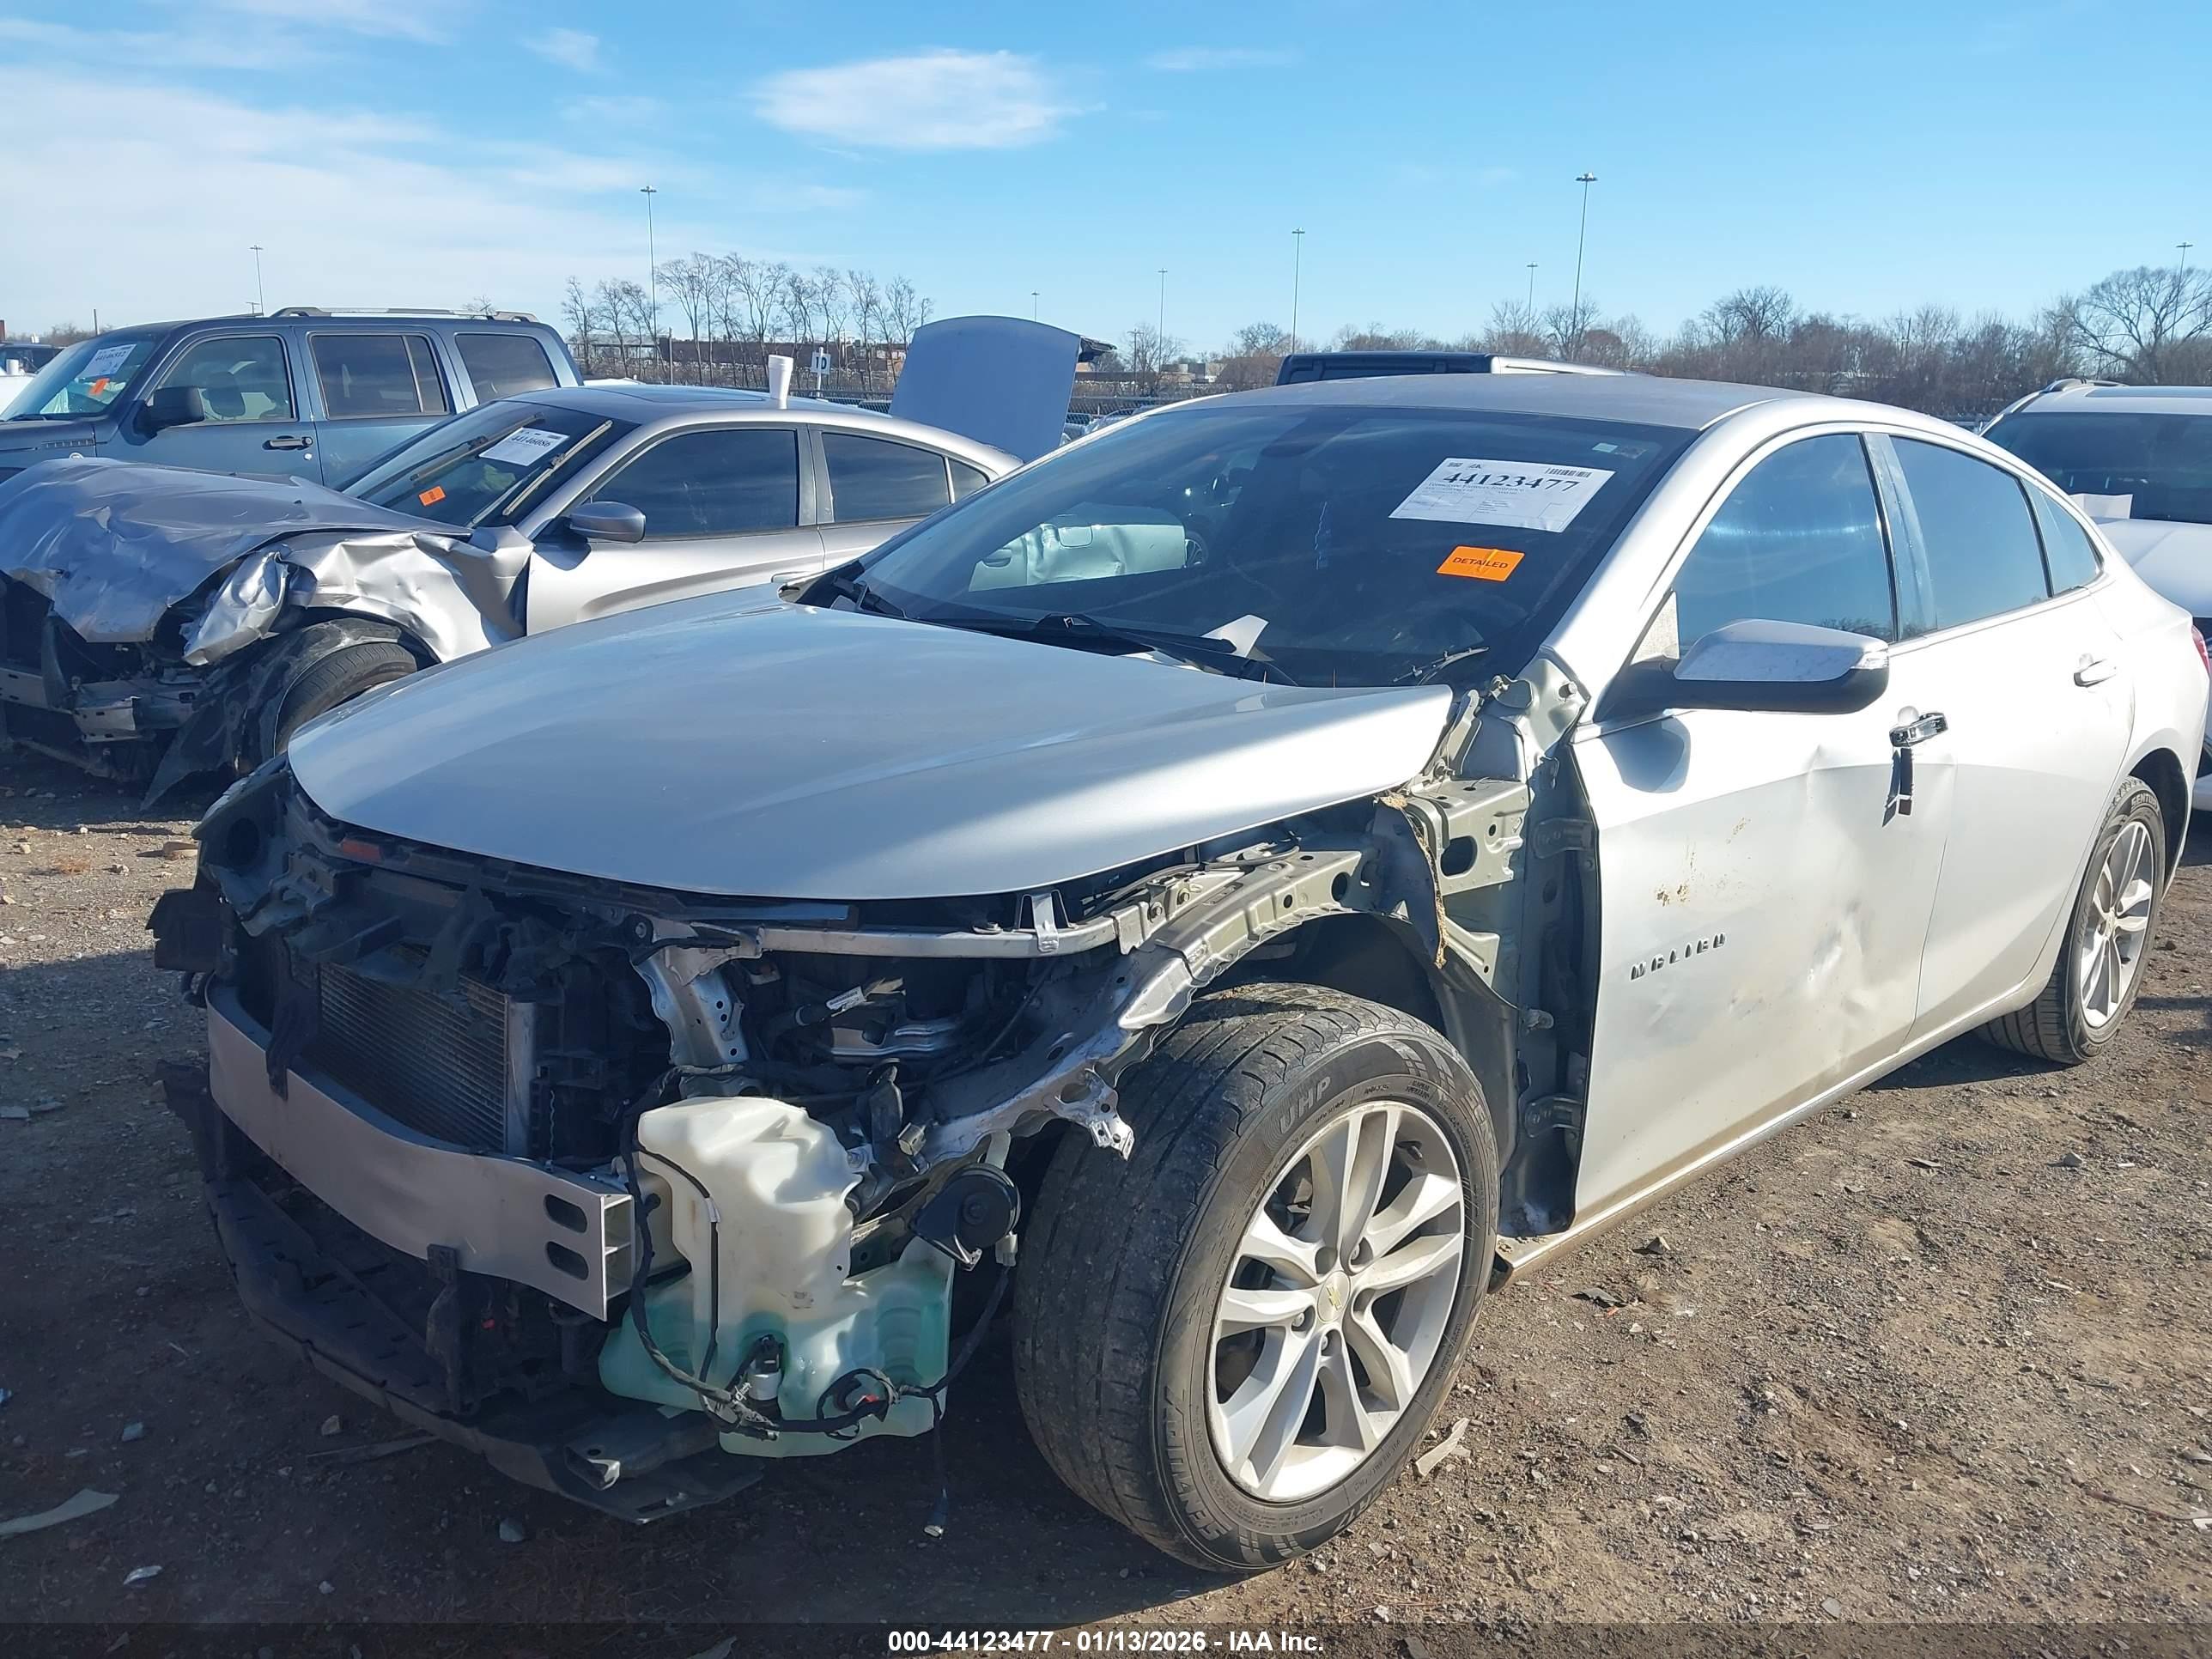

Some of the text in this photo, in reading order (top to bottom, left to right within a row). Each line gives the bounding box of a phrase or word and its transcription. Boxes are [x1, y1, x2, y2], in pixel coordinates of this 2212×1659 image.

[1443, 472, 1581, 492] 44123477
[1452, 556, 1509, 568] DETAILED
[1279, 1075, 1331, 1135] UHP
